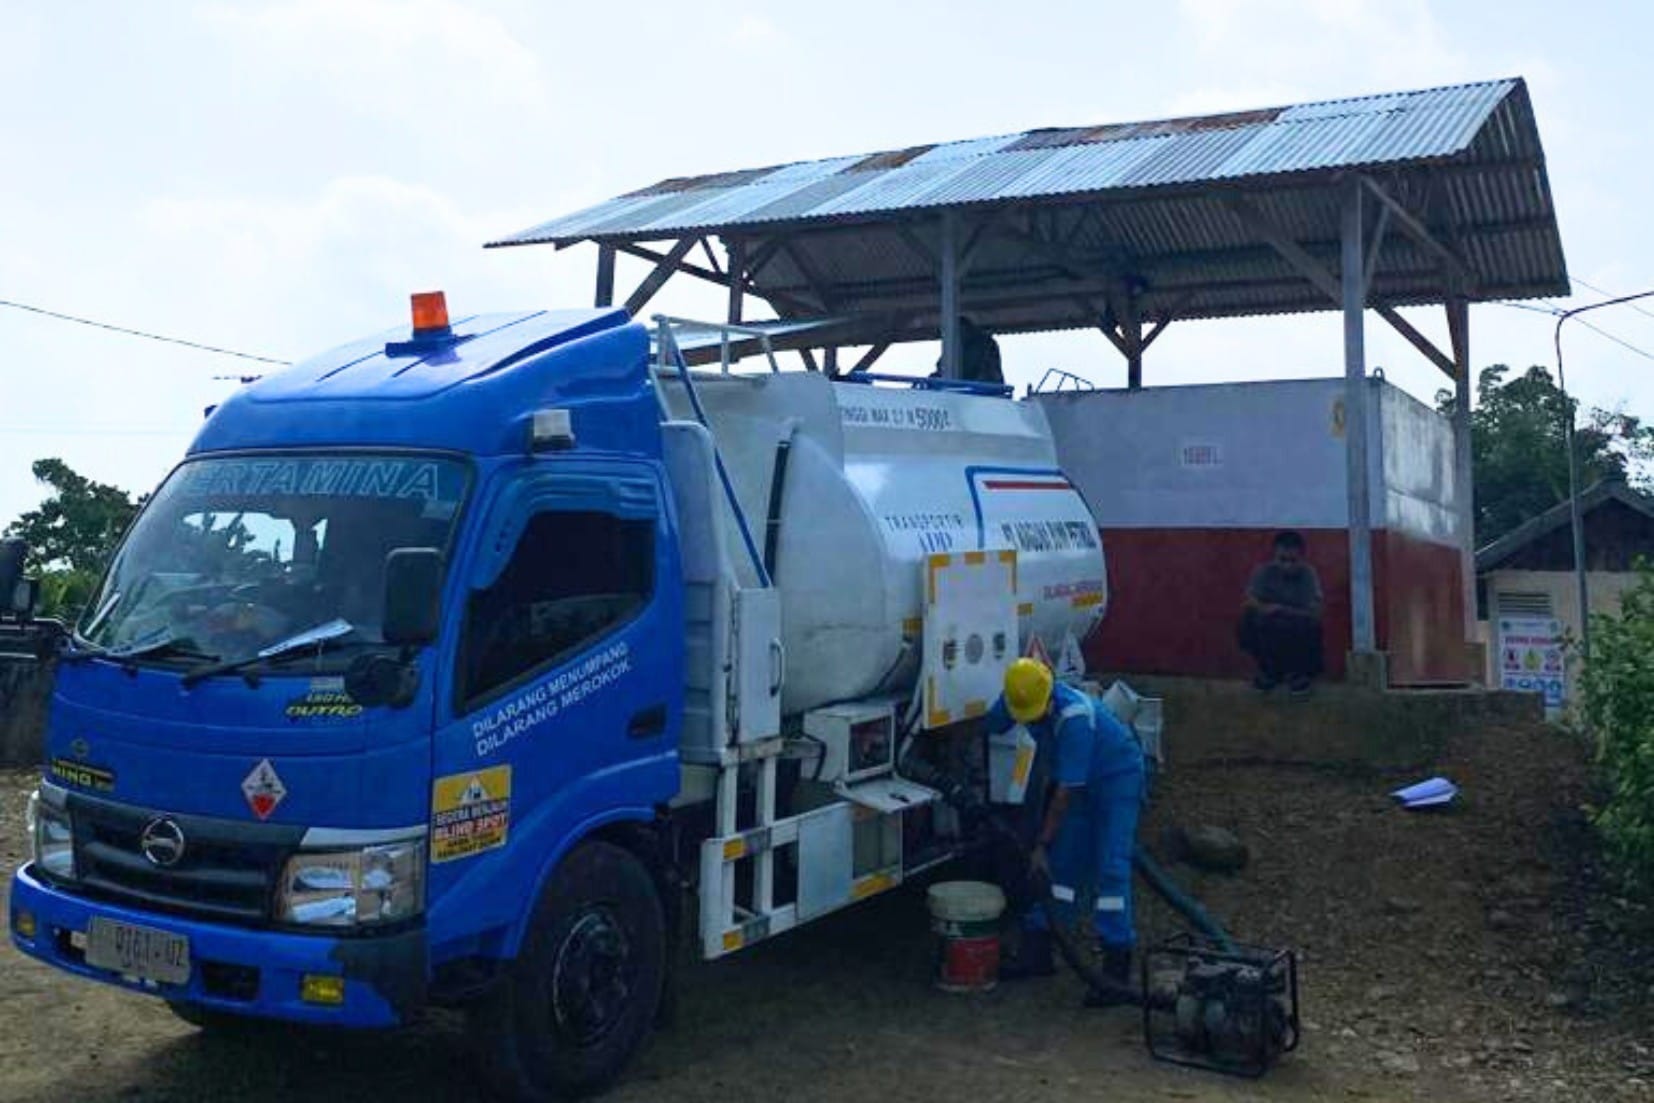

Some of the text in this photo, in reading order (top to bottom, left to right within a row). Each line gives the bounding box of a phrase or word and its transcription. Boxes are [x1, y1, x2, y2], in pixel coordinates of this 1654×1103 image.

[184, 458, 439, 501] ERTAMINA
[472, 686, 547, 739] DILARANG
[476, 659, 631, 757] DILARANG MEROKOK
